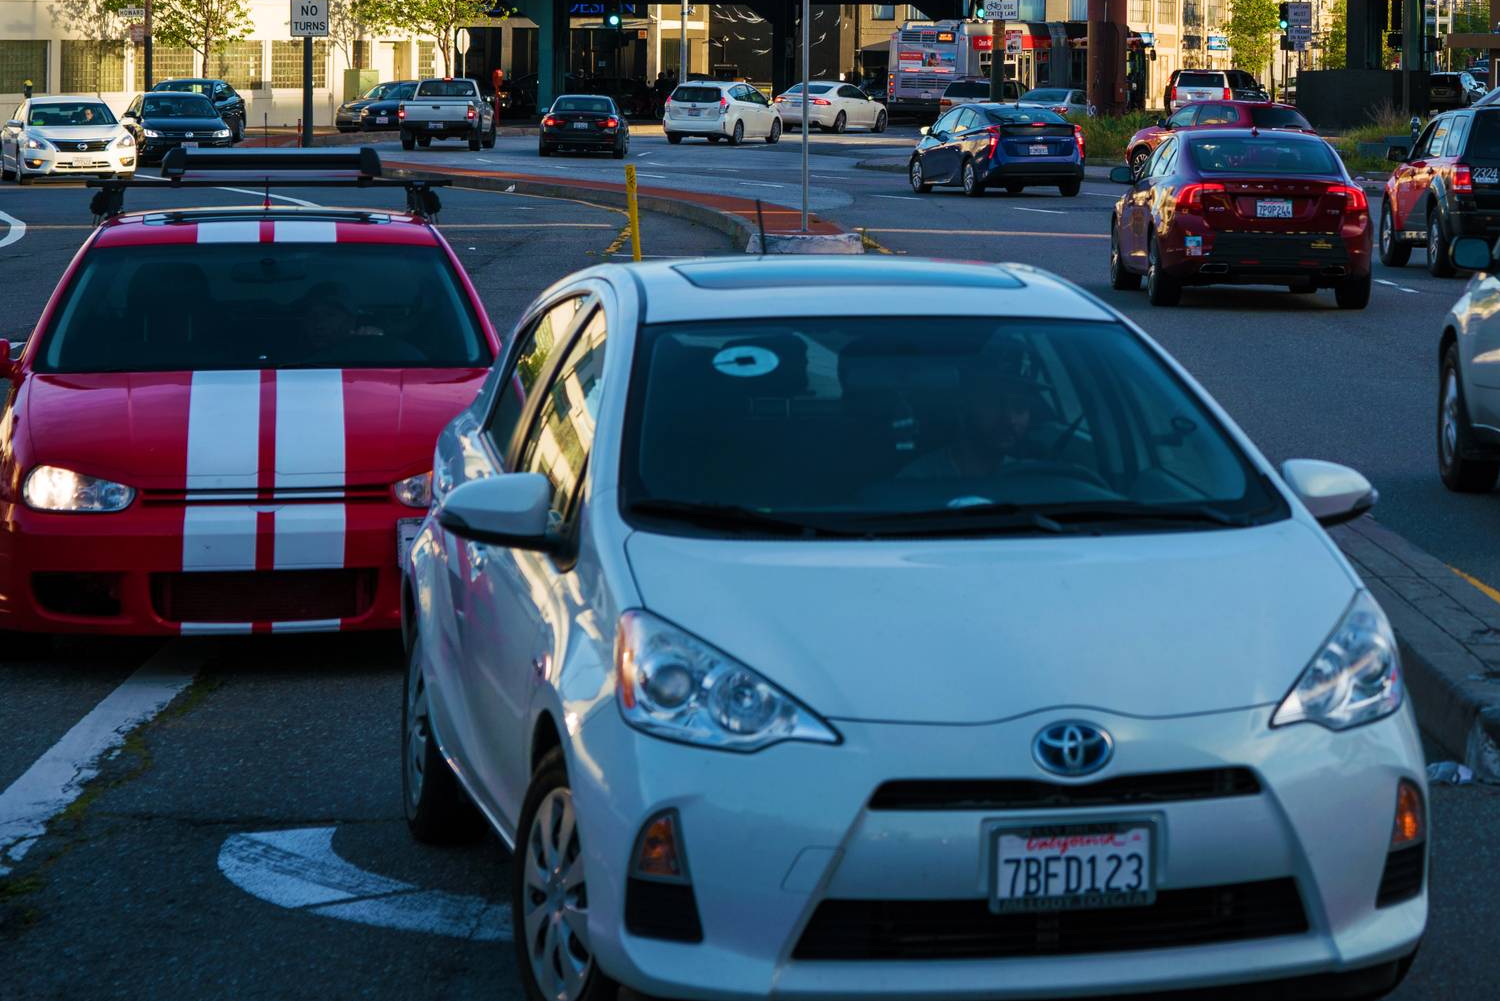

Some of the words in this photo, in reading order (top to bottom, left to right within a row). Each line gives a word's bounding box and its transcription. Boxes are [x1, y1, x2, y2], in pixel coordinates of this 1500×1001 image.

[301, 5, 318, 16] NO
[293, 21, 325, 31] TURNS
[1473, 167, 1499, 179] 2324
[1003, 853, 1144, 898] 7BFD123
